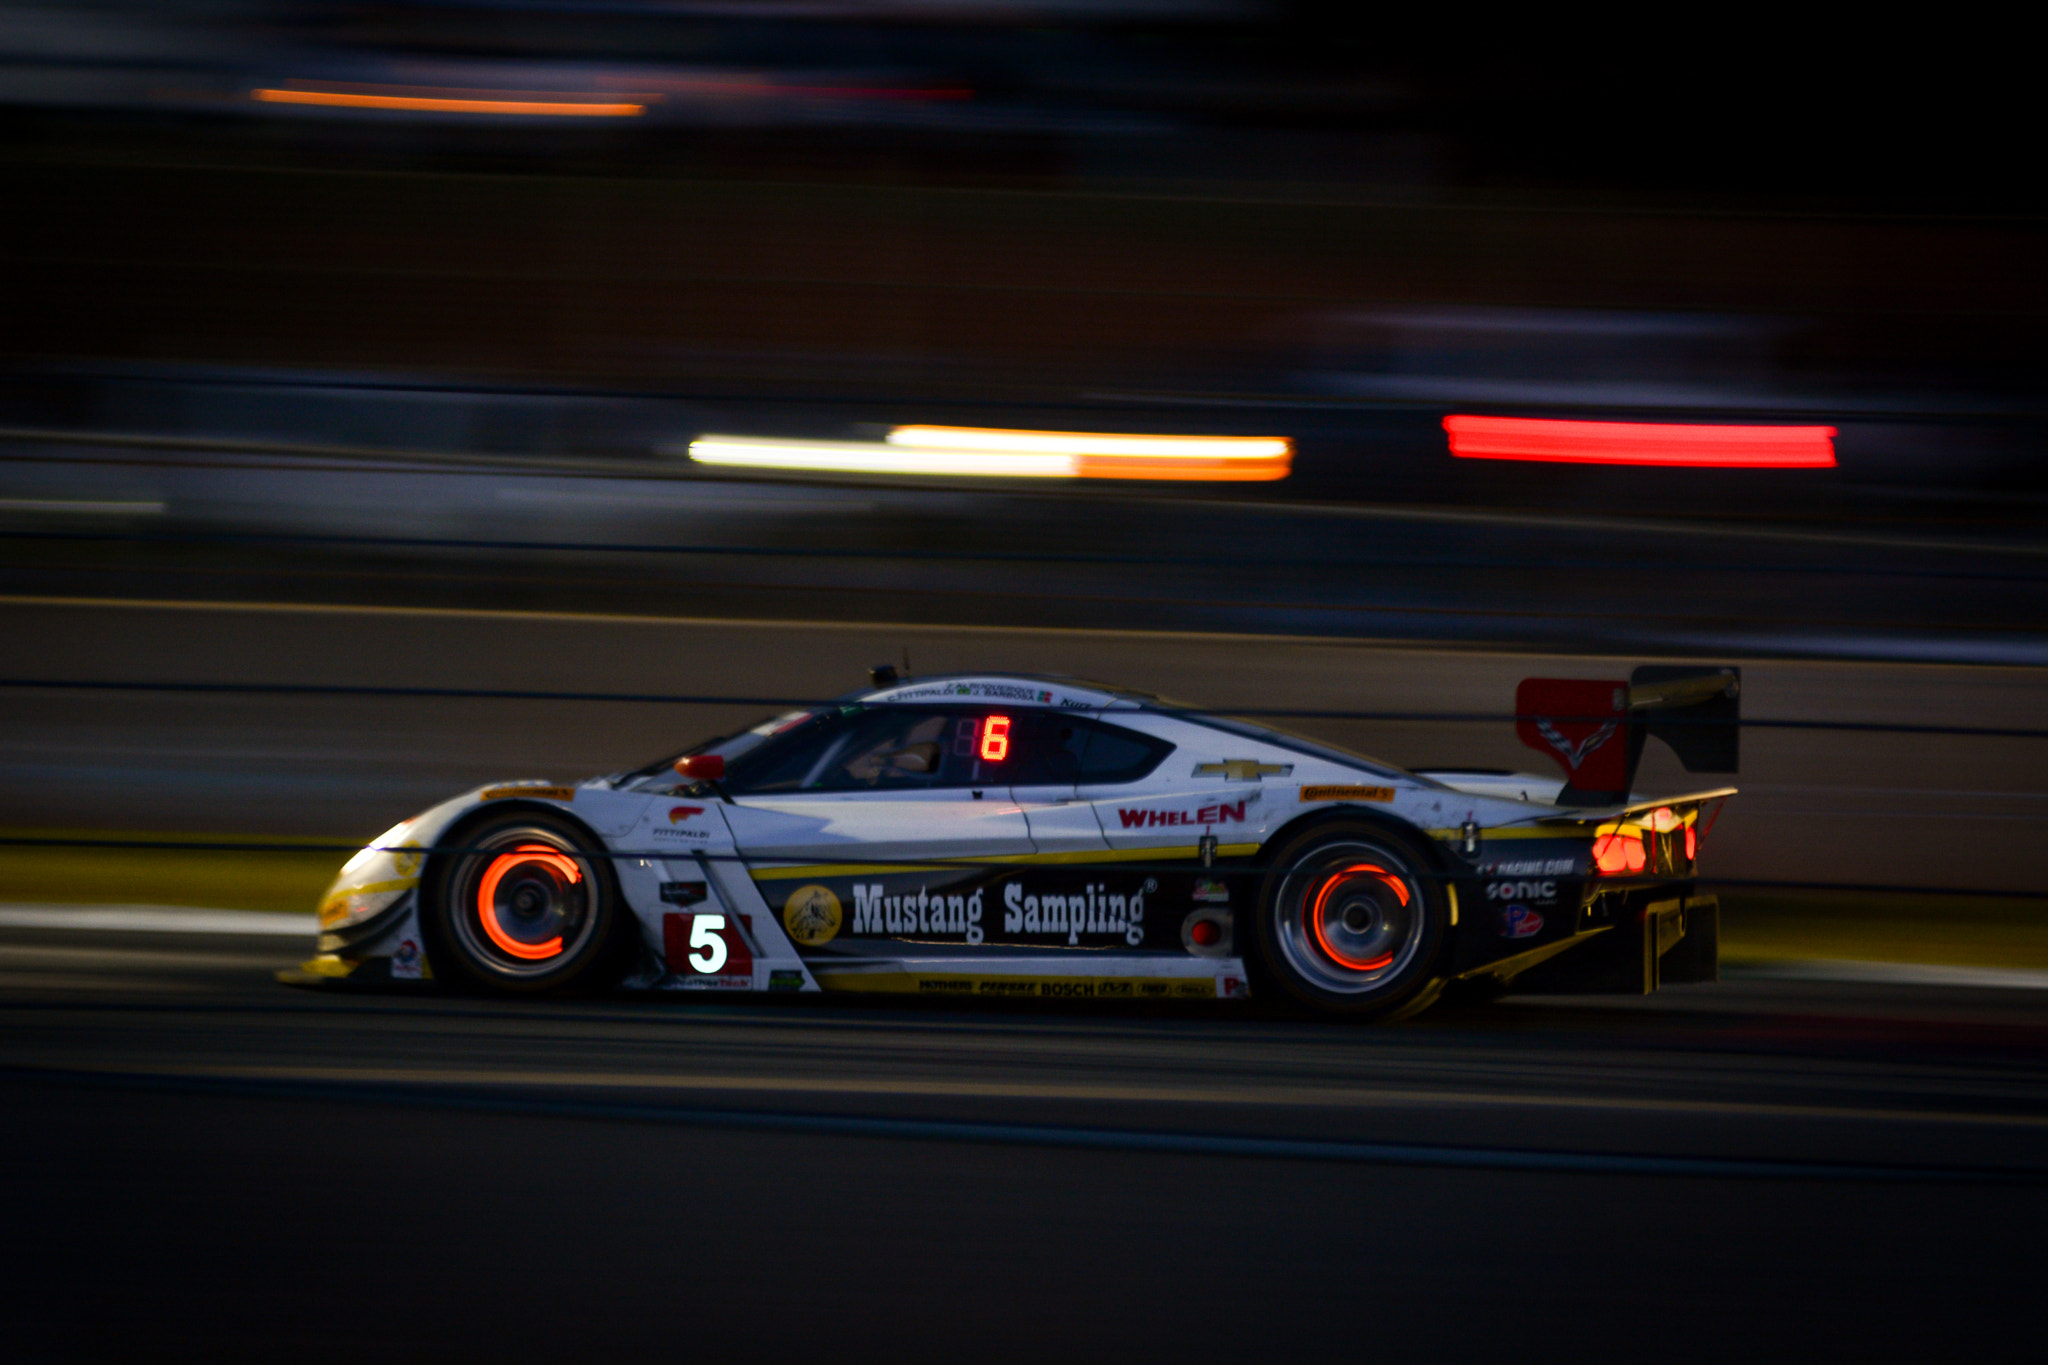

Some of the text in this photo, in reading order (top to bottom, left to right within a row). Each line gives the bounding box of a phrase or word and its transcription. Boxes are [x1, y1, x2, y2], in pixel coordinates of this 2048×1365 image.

[984, 689, 1034, 701] BARBOSA
[981, 715, 1010, 761] 6
[1303, 786, 1378, 800] Continental
[1119, 801, 1246, 829] WHELEN
[653, 829, 711, 840] FITTIPALDI
[852, 883, 985, 945] Mustang
[688, 913, 728, 974] 5
[1041, 983, 1094, 996] BOSCH
